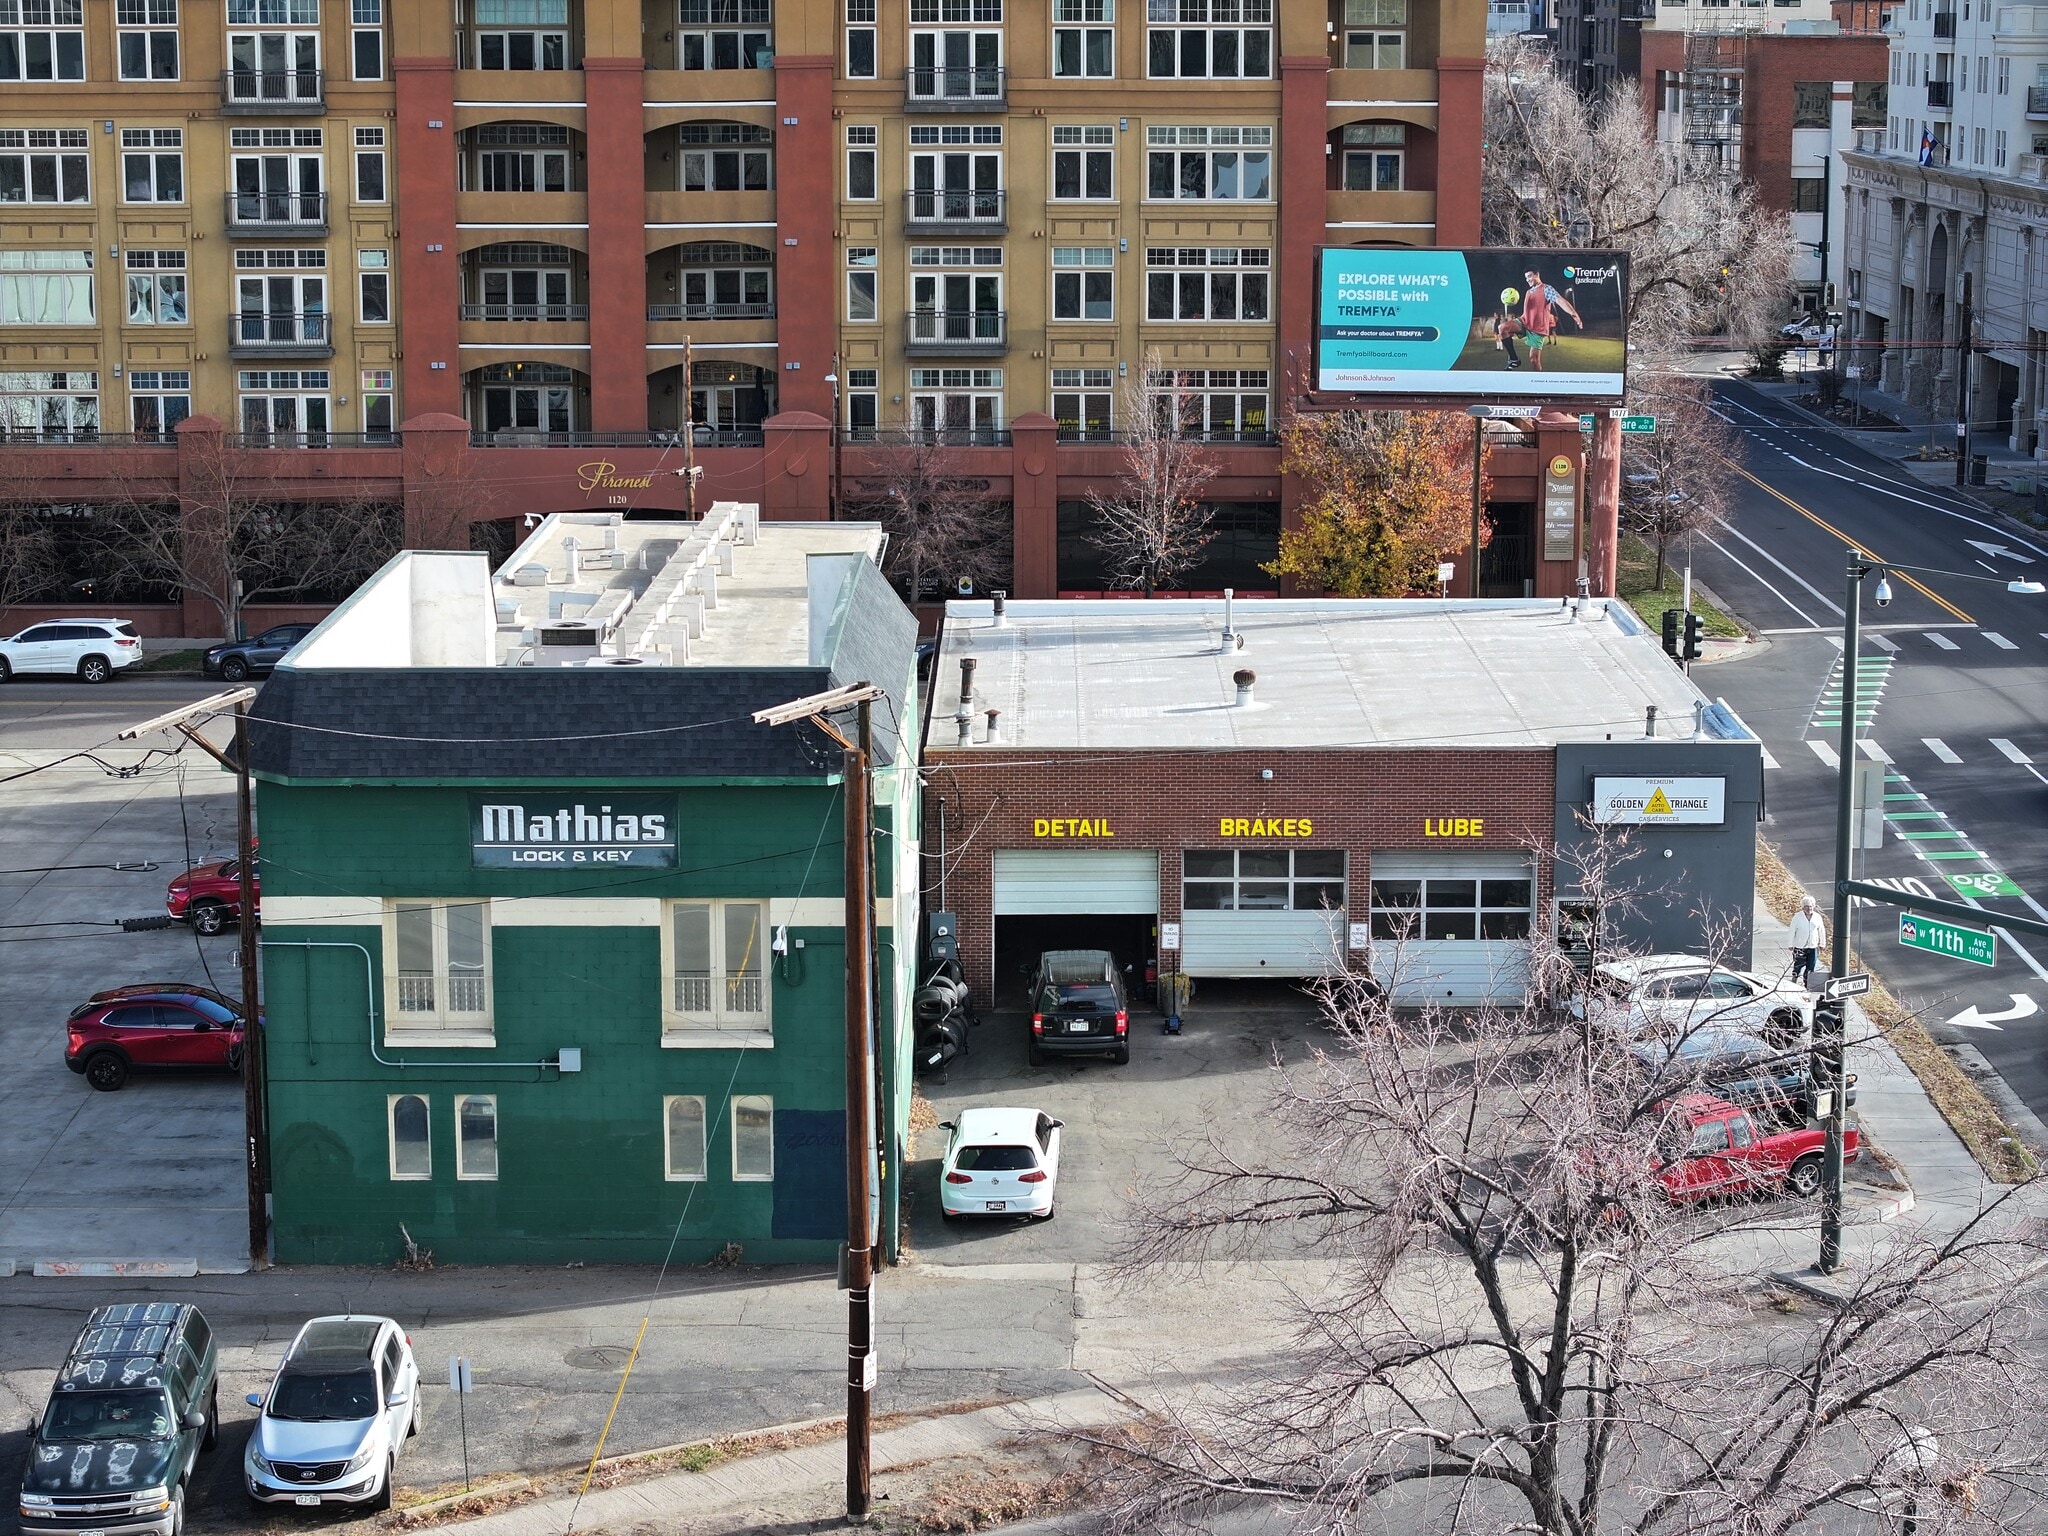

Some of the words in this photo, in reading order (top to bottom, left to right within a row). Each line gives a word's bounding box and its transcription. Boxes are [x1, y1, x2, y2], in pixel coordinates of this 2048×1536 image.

[1338, 273, 1395, 286] EXPLORE
[1575, 267, 1614, 279] Tremfya
[1338, 289, 1398, 301] POSSIBLE
[1401, 291, 1429, 302] with
[1336, 350, 1408, 358] Tremfyabillboard.com
[577, 457, 653, 500] Piranesi
[608, 495, 627, 504] 1120
[1610, 800, 1643, 809] GOLDEN
[1670, 799, 1708, 809] TRIANGLE
[482, 804, 665, 842] Mathias
[1034, 818, 1114, 837] DETAIL
[1220, 818, 1313, 837] BRAKES
[1425, 818, 1484, 837] LUBE
[512, 850, 566, 862] LOCK
[572, 850, 587, 862] &
[592, 850, 633, 862] KEY
[1919, 928, 1926, 939] W
[1929, 927, 1964, 954] 11th
[1973, 938, 1987, 947] Ave
[1968, 946, 1984, 958] 1100
[1986, 950, 1992, 960] N
[1838, 983, 1850, 993] ONE
[1852, 980, 1865, 990] WAY
